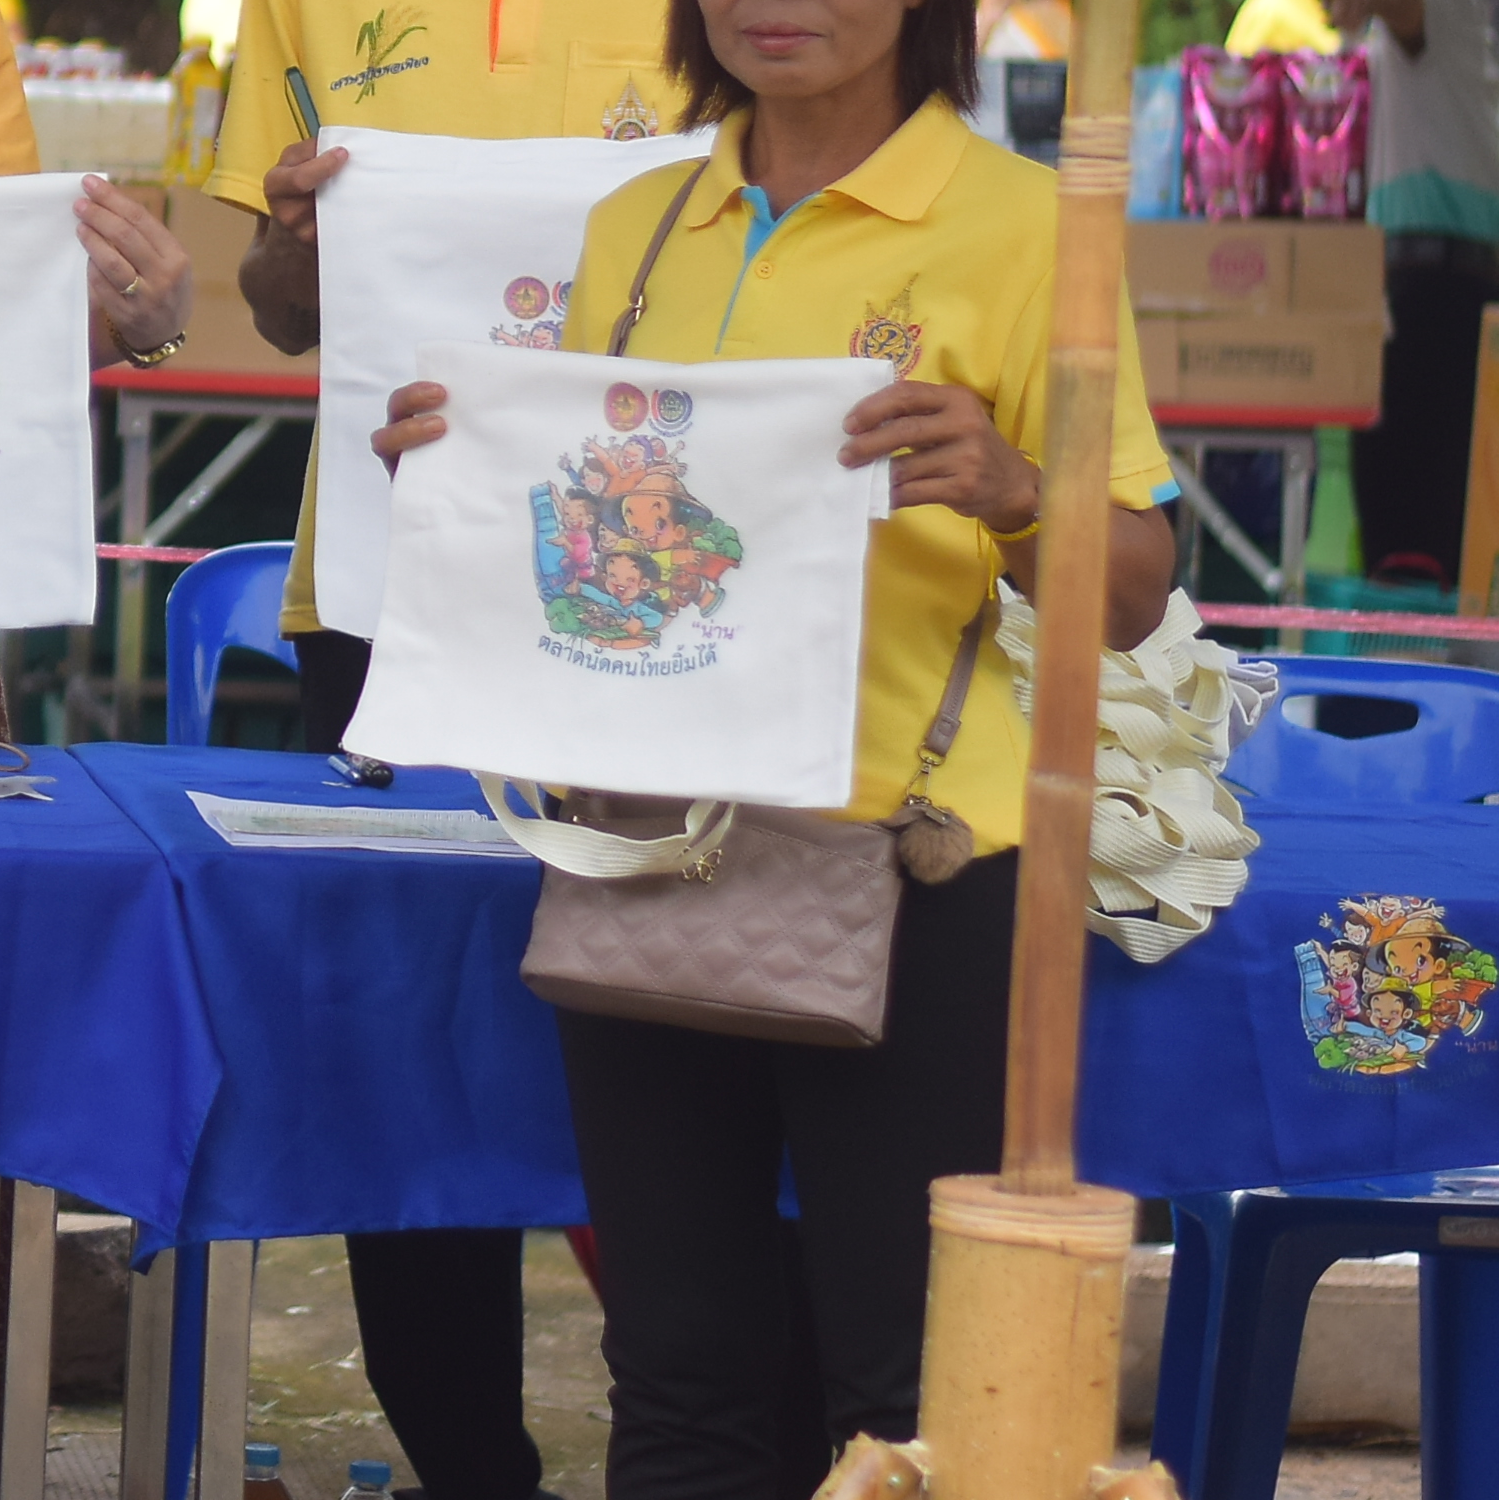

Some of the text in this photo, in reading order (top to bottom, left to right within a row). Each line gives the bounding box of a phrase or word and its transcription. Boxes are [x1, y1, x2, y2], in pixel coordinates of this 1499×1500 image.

[538, 634, 717, 677] ตลาดนัดคนไทยยิ้มได้
